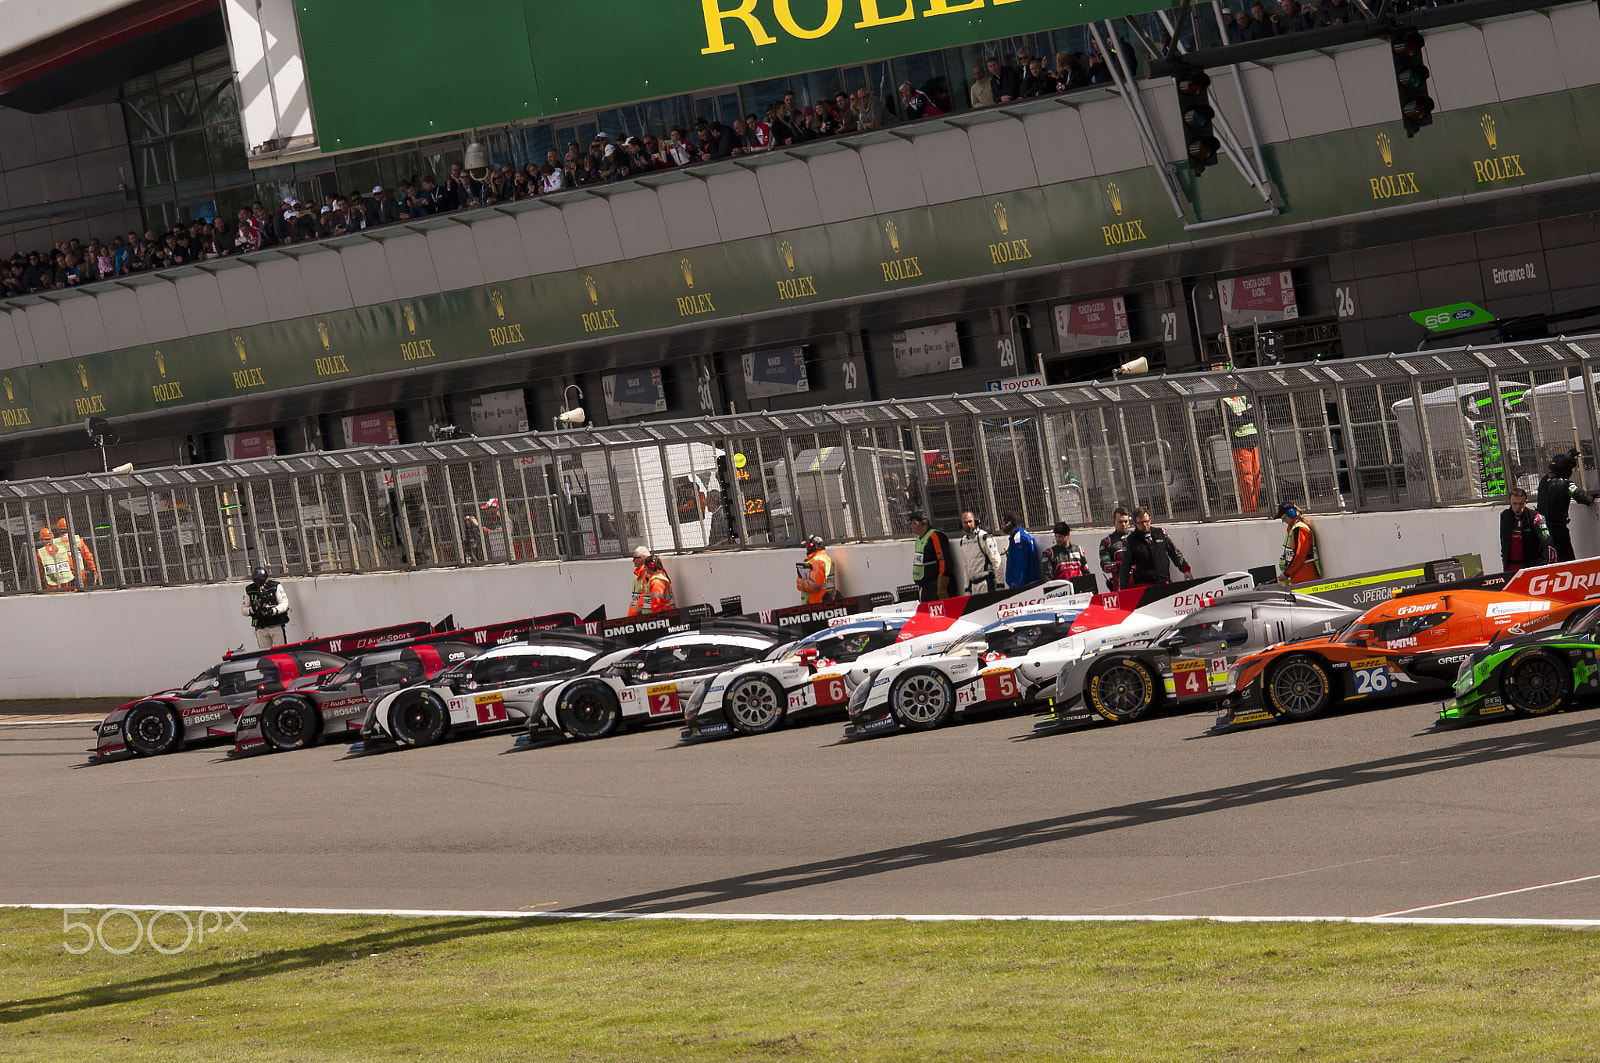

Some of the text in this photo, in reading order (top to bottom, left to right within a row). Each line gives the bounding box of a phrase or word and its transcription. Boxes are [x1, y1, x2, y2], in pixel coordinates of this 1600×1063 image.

[1473, 154, 1526, 184] ROLEX
[1369, 172, 1420, 200] ROLEX
[1101, 219, 1147, 246] ROLEX
[988, 239, 1032, 265] ROLEX
[880, 256, 922, 282] ROLEX
[1492, 262, 1536, 284] Entrance 02
[776, 276, 817, 300] ROLEX
[676, 293, 716, 316] ROLEX
[1335, 287, 1355, 317] 26
[581, 309, 619, 332] ROLEX
[1161, 312, 1177, 341] 27
[1425, 312, 1450, 329] 66
[489, 324, 525, 347] ROLEX
[400, 340, 436, 361] ROLEX
[997, 339, 1014, 367] 28
[315, 355, 349, 376] ROLEX
[232, 367, 265, 389] ROLEX
[842, 361, 857, 390] 29
[1003, 378, 1042, 391] TOYOTA
[152, 381, 184, 402] ROLEX
[75, 395, 106, 415] ROLEX
[2, 408, 31, 427] ROLEX
[1482, 577, 1505, 586] JOTA
[1529, 571, 1600, 596] G-DRI
[778, 598, 857, 616] PORSCHE
[1104, 595, 1118, 609] HY
[1174, 589, 1224, 608] DENSO
[759, 610, 773, 625] HY
[779, 613, 811, 627] DMG
[812, 608, 847, 623] MORI
[930, 604, 943, 616] HY
[1398, 603, 1439, 616] G-DRIVE
[603, 610, 680, 628] PORSCHE
[604, 619, 670, 637] DMG MORI
[387, 631, 411, 643] Sport
[474, 630, 488, 644] HY
[585, 622, 598, 635] HY
[329, 639, 342, 653] HY
[1176, 661, 1201, 670] DHL
[1213, 659, 1226, 671] P1
[1356, 660, 1382, 668] DHL
[1000, 674, 1014, 696] 5
[1186, 672, 1199, 692] 4
[1356, 667, 1387, 694] 26
[479, 694, 501, 702] DHL
[621, 691, 633, 700] P1
[829, 680, 843, 701] 6
[958, 691, 969, 702] P1
[190, 702, 227, 715] Audi Sport
[330, 696, 367, 708] Audi Sport
[450, 700, 461, 709] P1
[659, 694, 671, 711] 2
[790, 695, 800, 708] P1
[194, 712, 221, 724] BOSCH
[333, 706, 361, 717] BOSCH
[485, 704, 497, 720] 1
